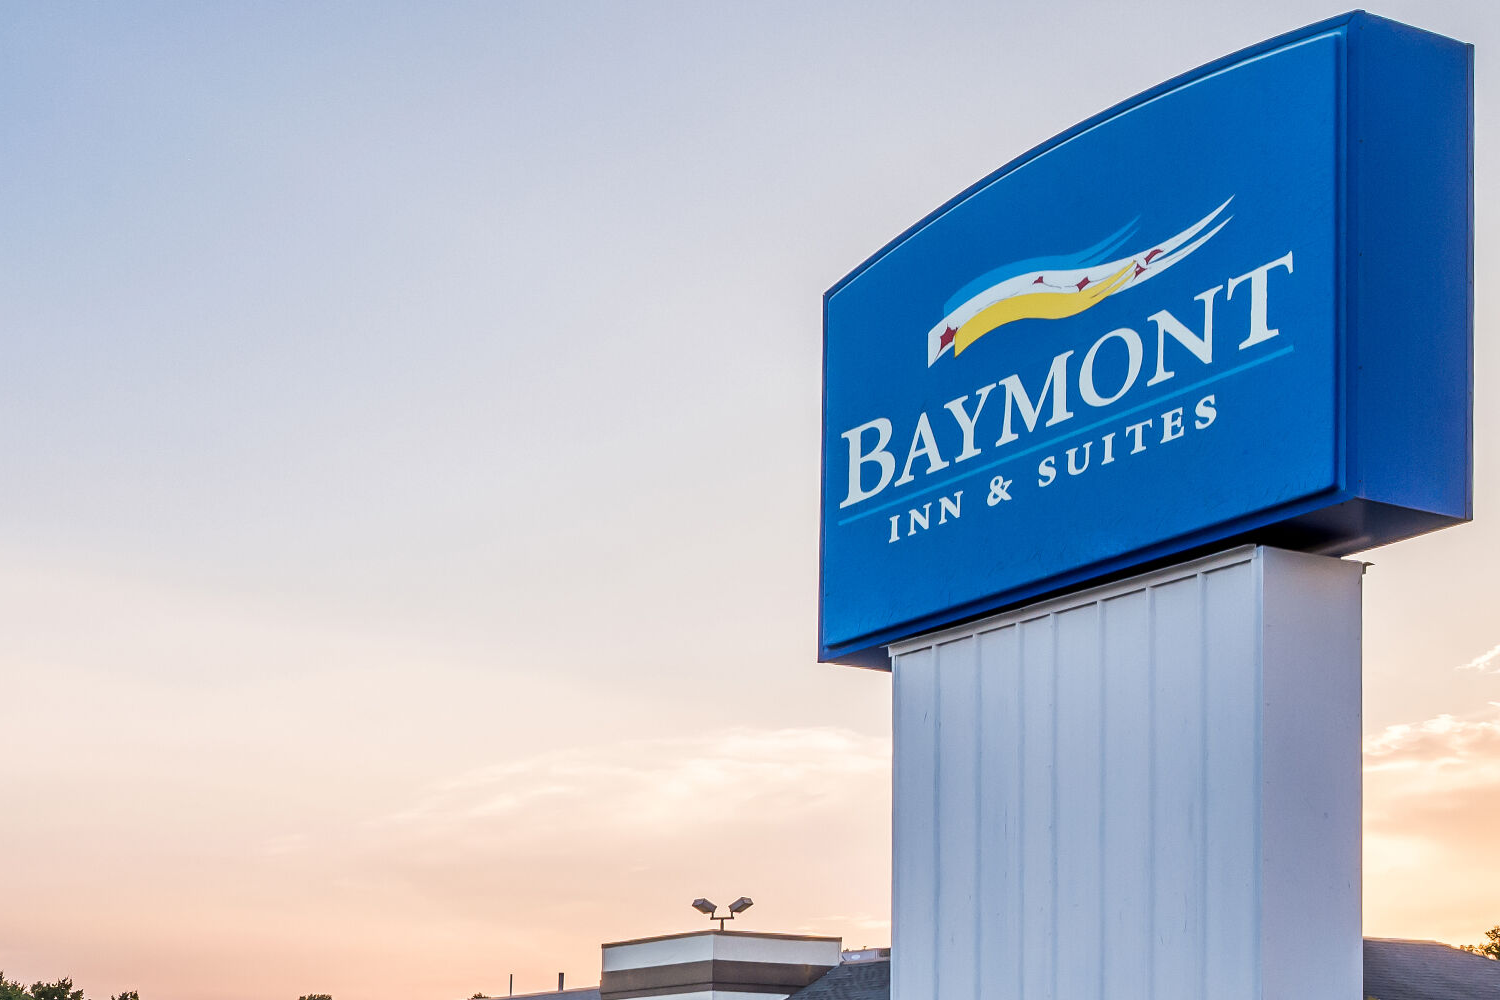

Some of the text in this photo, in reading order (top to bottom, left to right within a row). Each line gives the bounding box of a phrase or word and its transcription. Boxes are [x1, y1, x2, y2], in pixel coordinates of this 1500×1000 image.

[839, 250, 1294, 509] BAYMONT
[888, 394, 1219, 544] INN & SUITES
